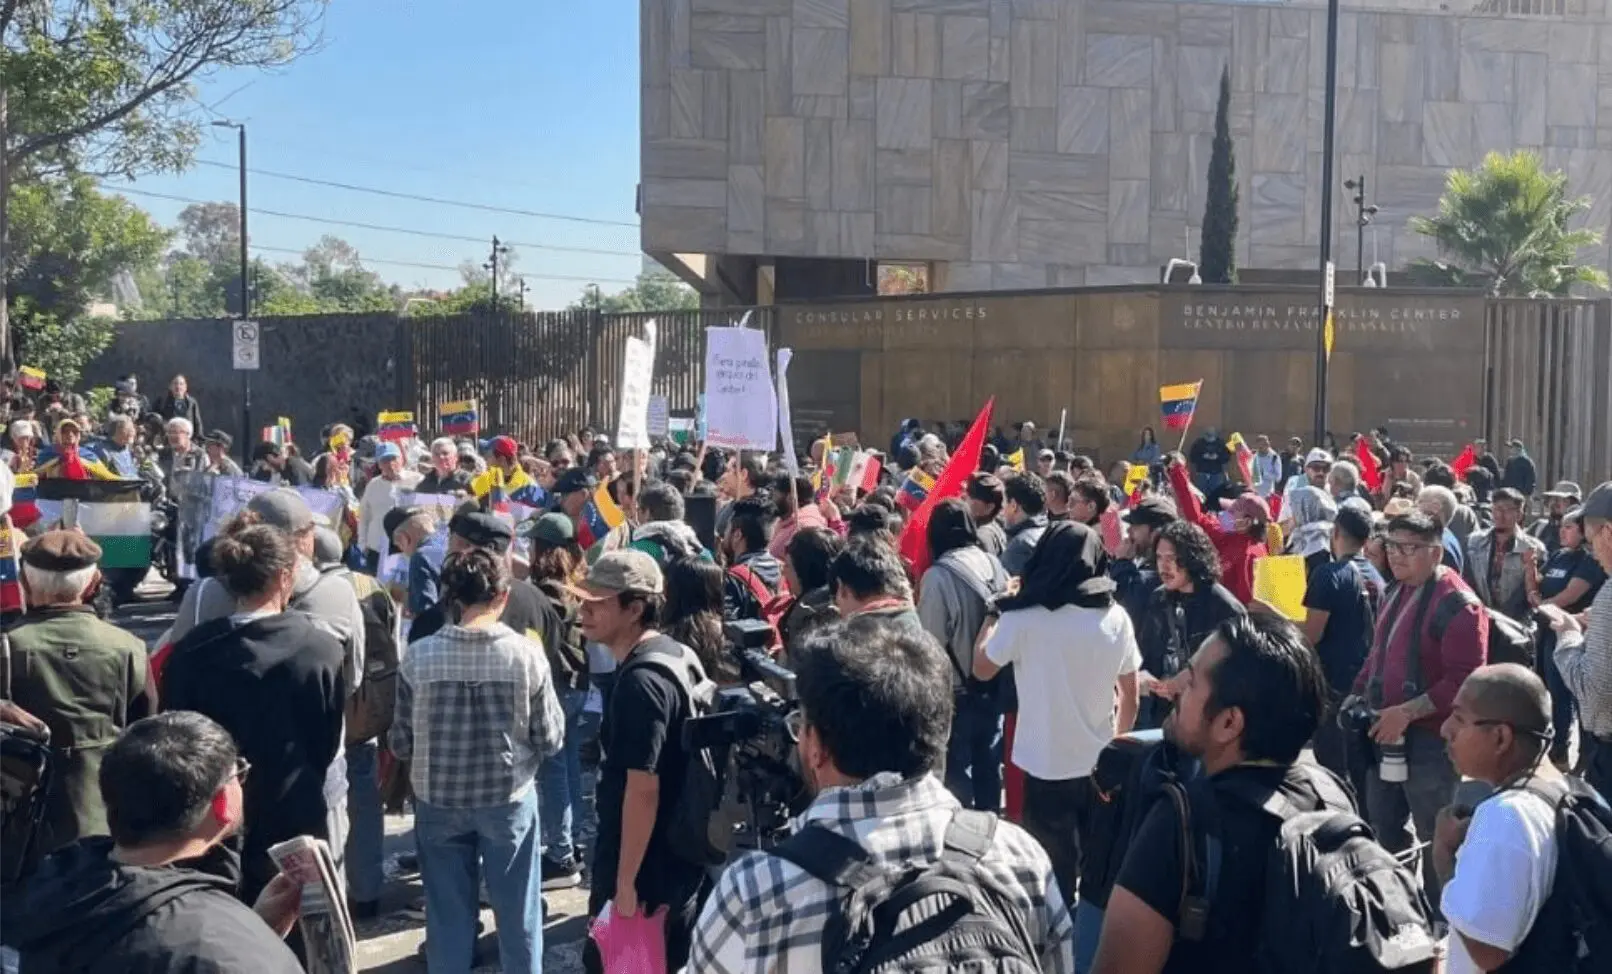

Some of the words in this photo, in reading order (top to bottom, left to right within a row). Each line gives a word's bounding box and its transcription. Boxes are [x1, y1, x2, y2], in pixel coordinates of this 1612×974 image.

[795, 310, 883, 324] CONSULAR
[894, 307, 988, 322] SERVICES
[1183, 304, 1276, 317] BENJAMIN
[1287, 305, 1380, 318] FRAKLIN
[1390, 307, 1461, 319] CENTER
[1252, 319, 1320, 332] BENJAMI
